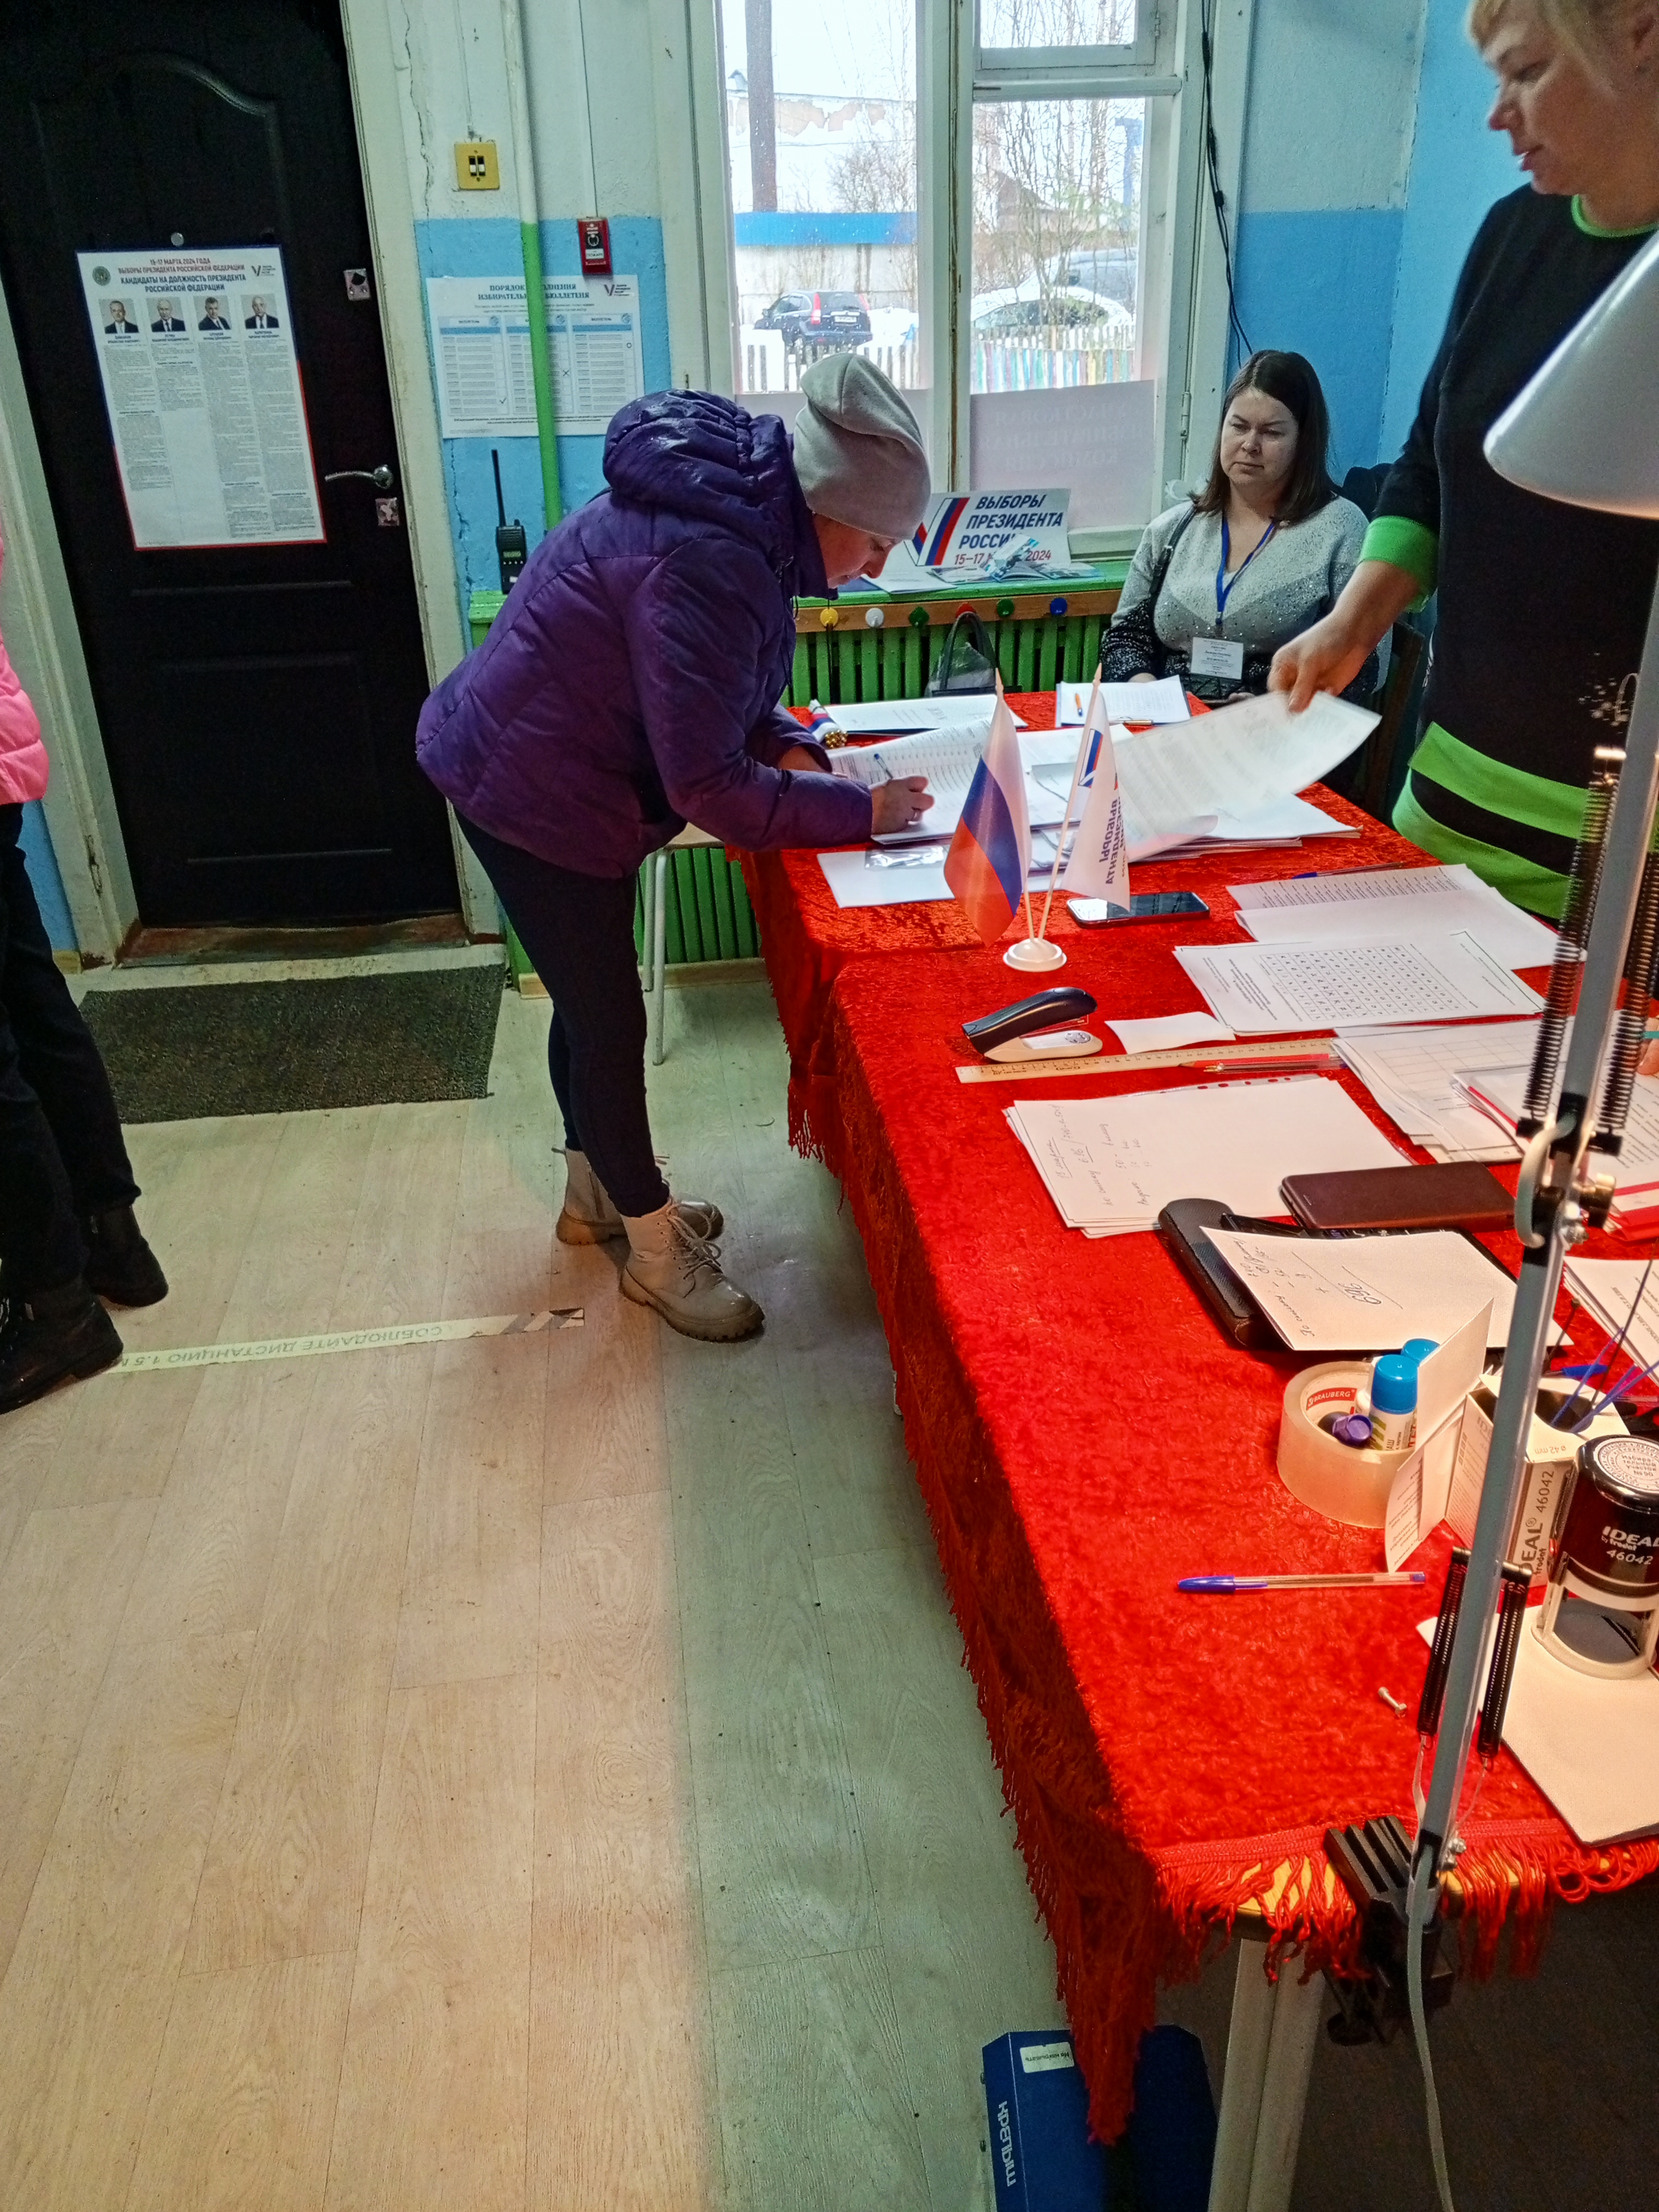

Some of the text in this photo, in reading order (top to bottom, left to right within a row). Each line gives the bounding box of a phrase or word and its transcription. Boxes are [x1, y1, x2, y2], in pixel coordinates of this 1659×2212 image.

[169, 275, 206, 284] ДОЛЖНОСТЬ
[207, 274, 246, 282] ПРЕЗИДЕНТА
[145, 283, 225, 292] РОССИЙСКОЙ ФЕДЕРАЦИИ
[975, 494, 1046, 510] ВЫБОРЫ
[966, 512, 1064, 530] ПРЕЗИДЕНТА
[958, 533, 1016, 549] РОССИ
[1027, 550, 1052, 561] 2024
[303, 1326, 443, 1350] СОБЛЮДАЙТЕ
[168, 1340, 297, 1363] ДИСТАНЦИЮ
[134, 1355, 159, 1366] 1.5
[1313, 1391, 1351, 1403] BRAUBERG
[1535, 1470, 1554, 1513] 46042
[1609, 1538, 1637, 1551] trodat
[1534, 1549, 1547, 1575] trodat
[1606, 1549, 1654, 1565] 46042
